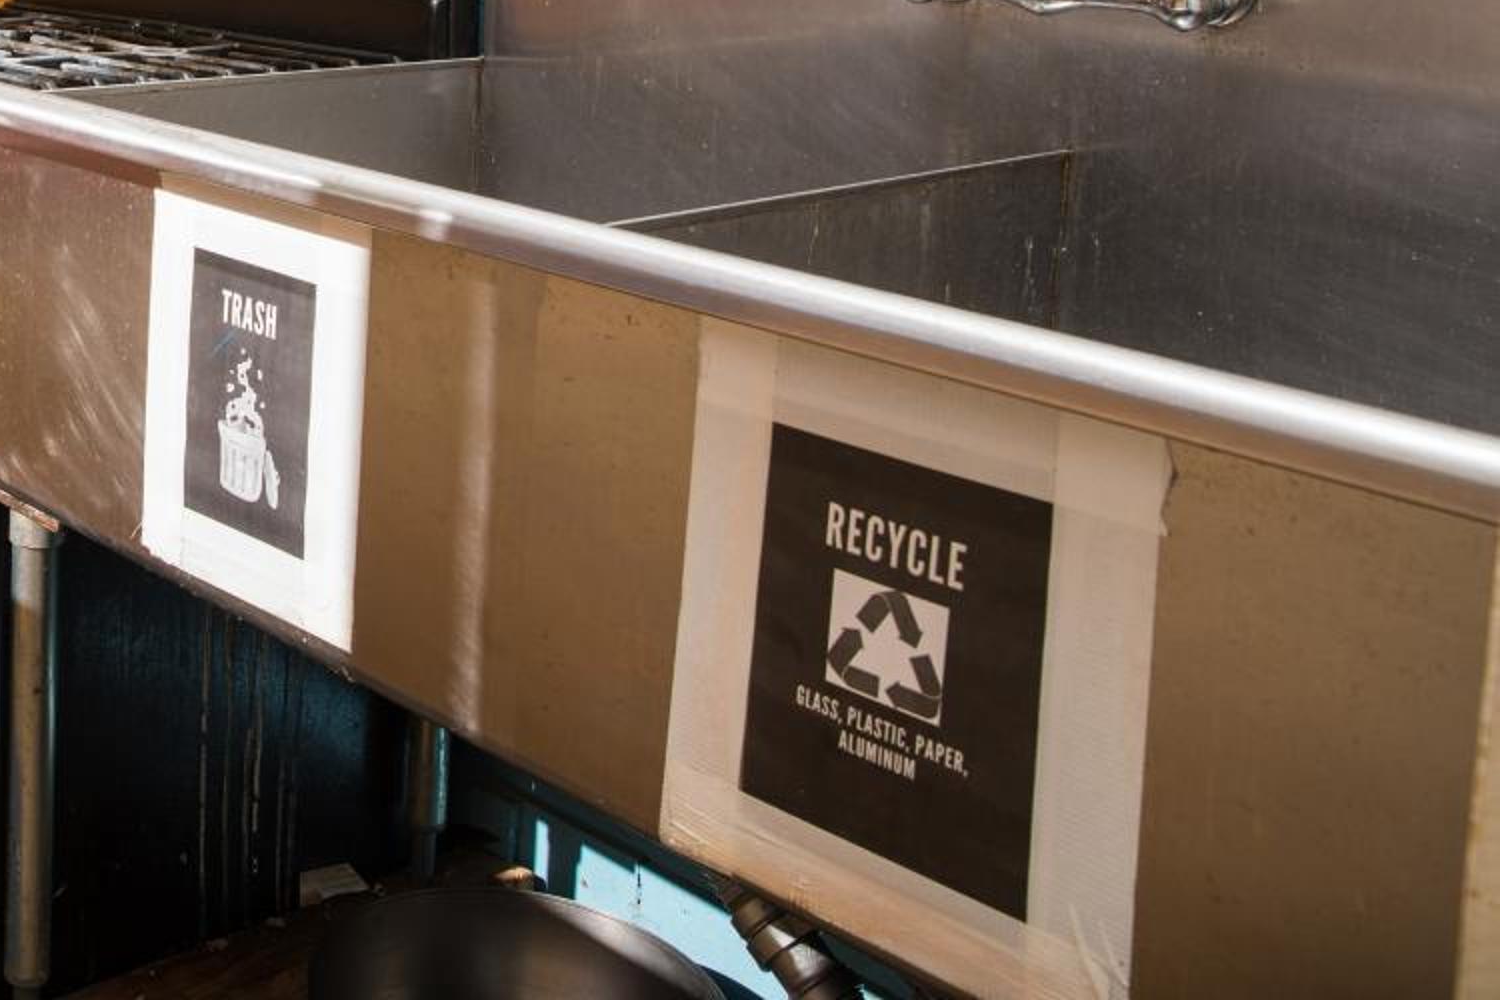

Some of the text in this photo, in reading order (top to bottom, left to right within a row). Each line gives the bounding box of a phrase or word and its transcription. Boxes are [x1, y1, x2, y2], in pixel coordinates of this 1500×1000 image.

[221, 289, 278, 341] TRASH
[825, 501, 968, 591] RECYCLE
[796, 684, 969, 778] GLASS, PLASTIC, PAPER,
[838, 729, 916, 780] ALUMINUM
